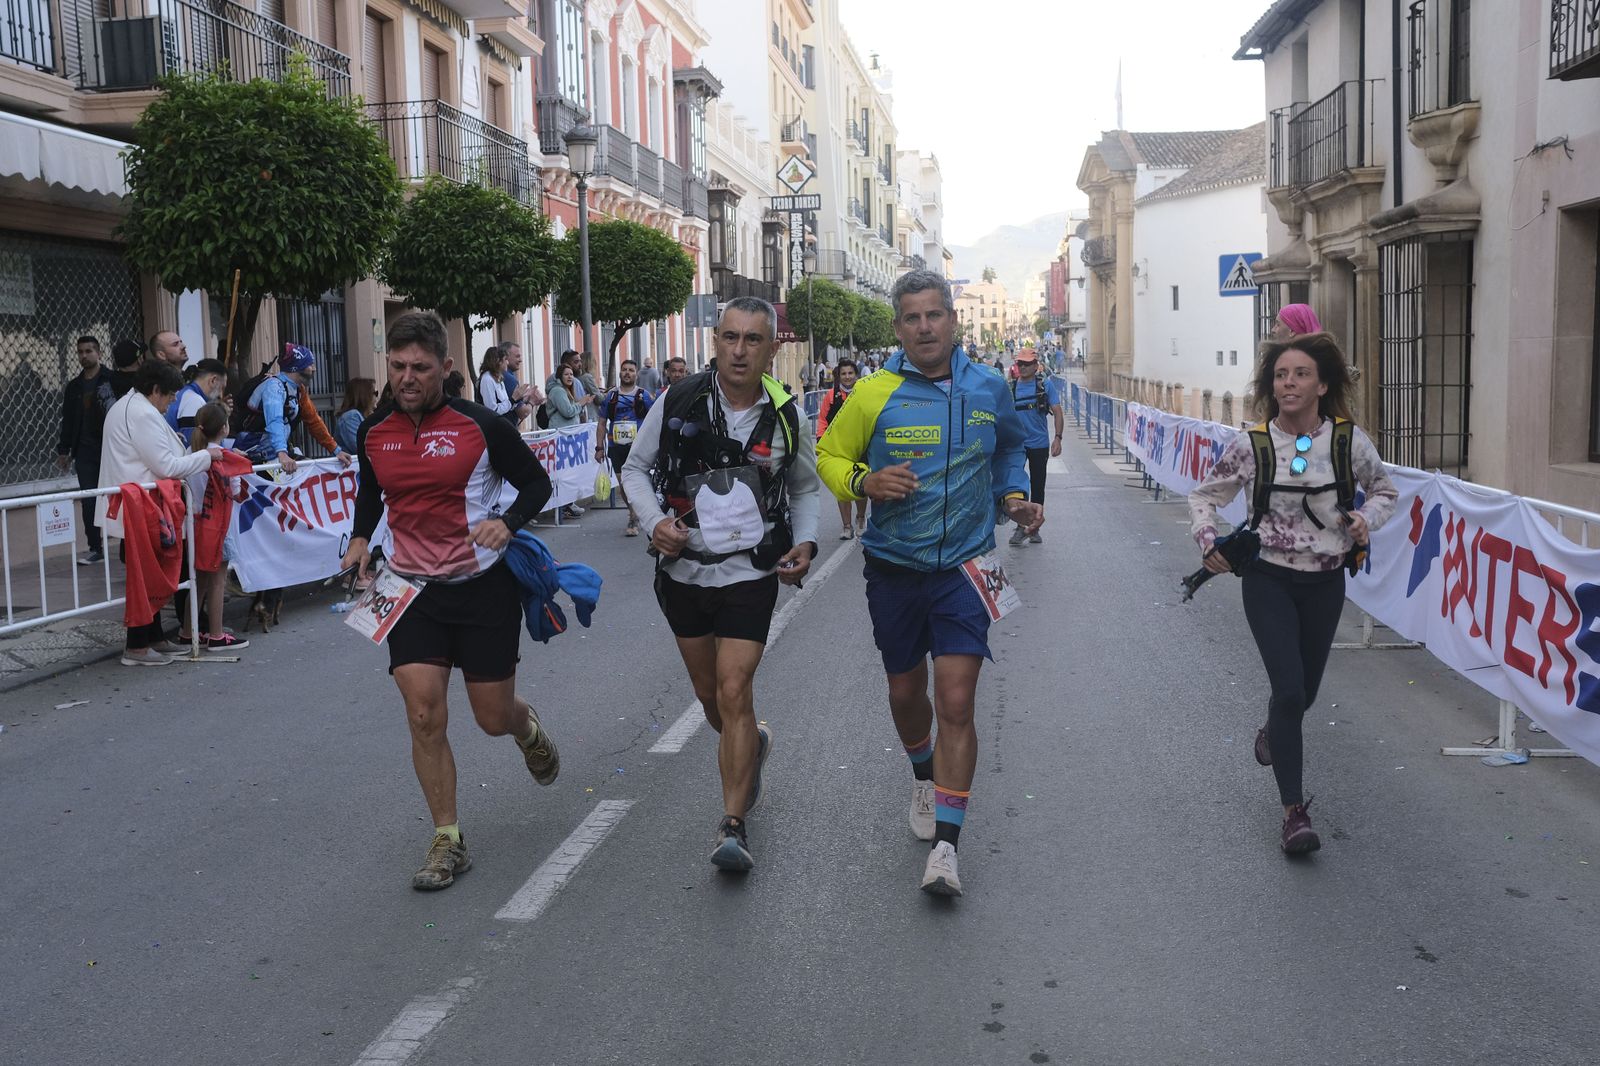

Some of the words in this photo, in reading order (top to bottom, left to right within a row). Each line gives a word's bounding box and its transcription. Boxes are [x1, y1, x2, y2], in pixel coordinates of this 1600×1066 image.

[773, 197, 793, 210] PEDRO
[795, 195, 819, 209] ROMERO
[270, 470, 359, 533] INTER
